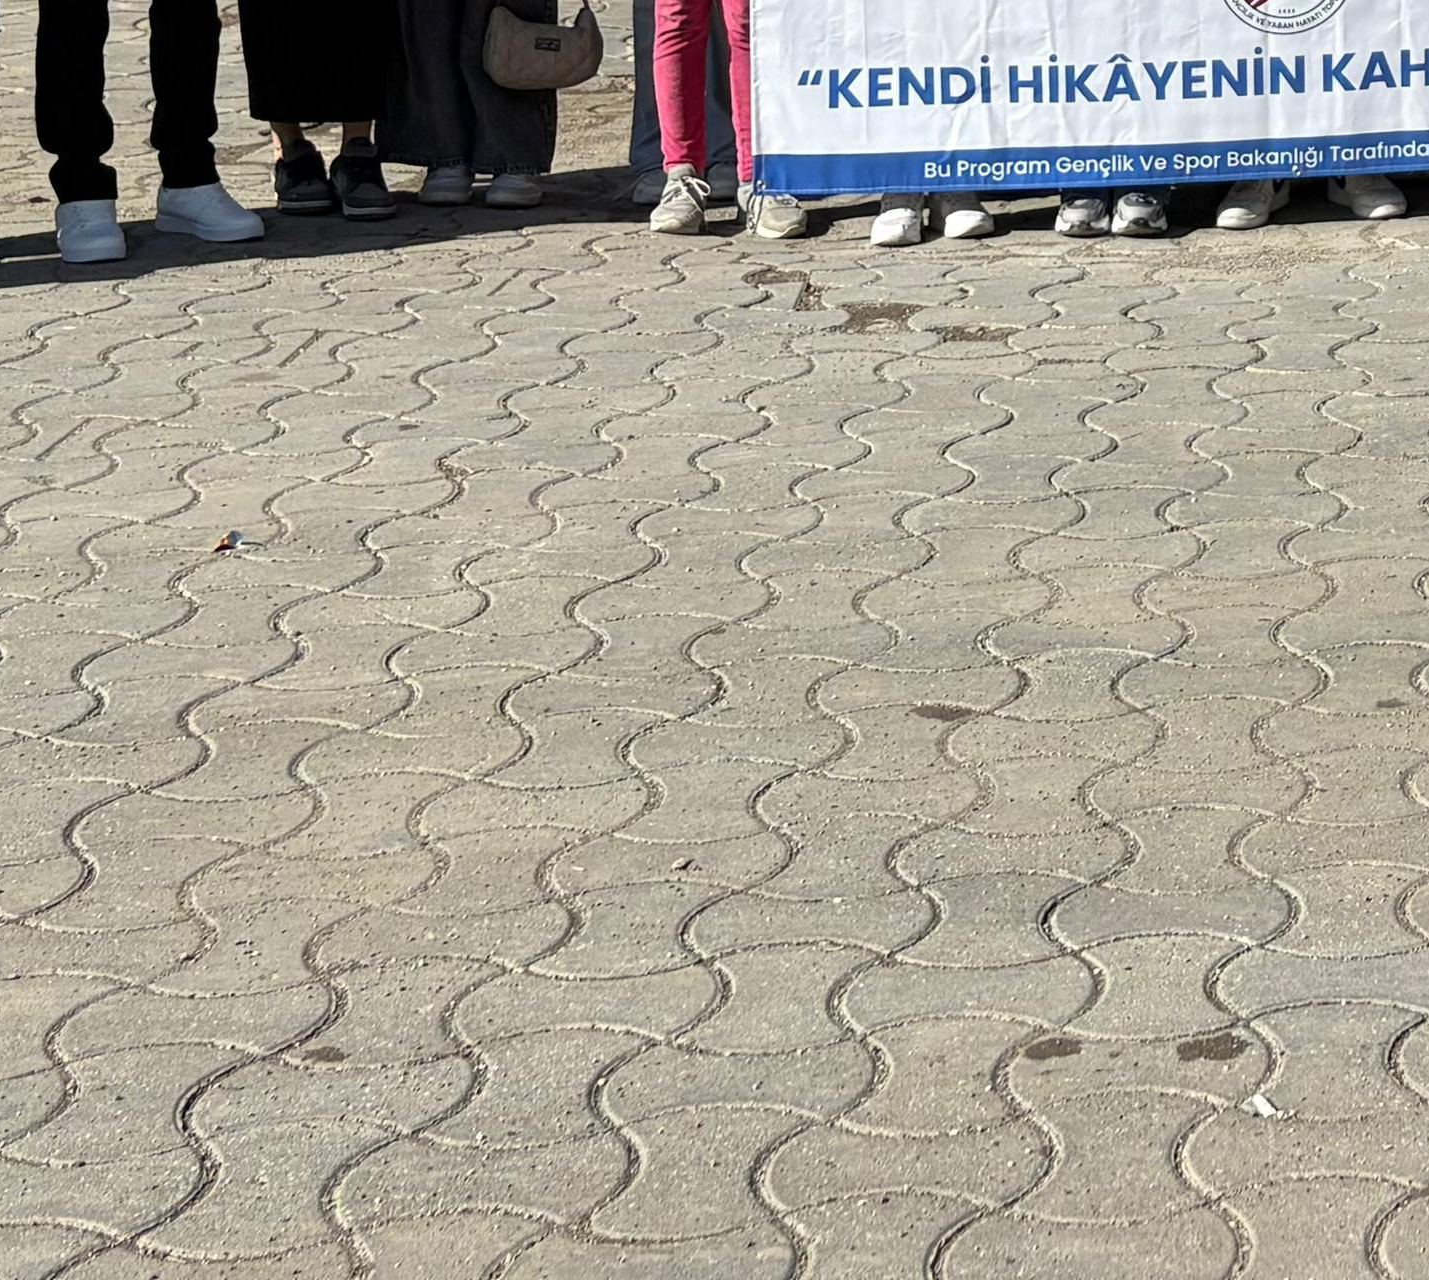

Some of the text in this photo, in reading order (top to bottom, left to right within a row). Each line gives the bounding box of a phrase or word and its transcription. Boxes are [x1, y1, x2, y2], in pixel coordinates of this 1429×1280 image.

[797, 53, 992, 109] “KENDİ
[1008, 46, 1305, 104] HİKÂYENİN
[924, 160, 952, 178] Bu
[957, 157, 1051, 181] Program
[1055, 153, 1134, 178] Gençlik
[1139, 154, 1167, 171] Ve
[1173, 153, 1220, 174] Spor
[1227, 145, 1324, 168] Bakanlığı
